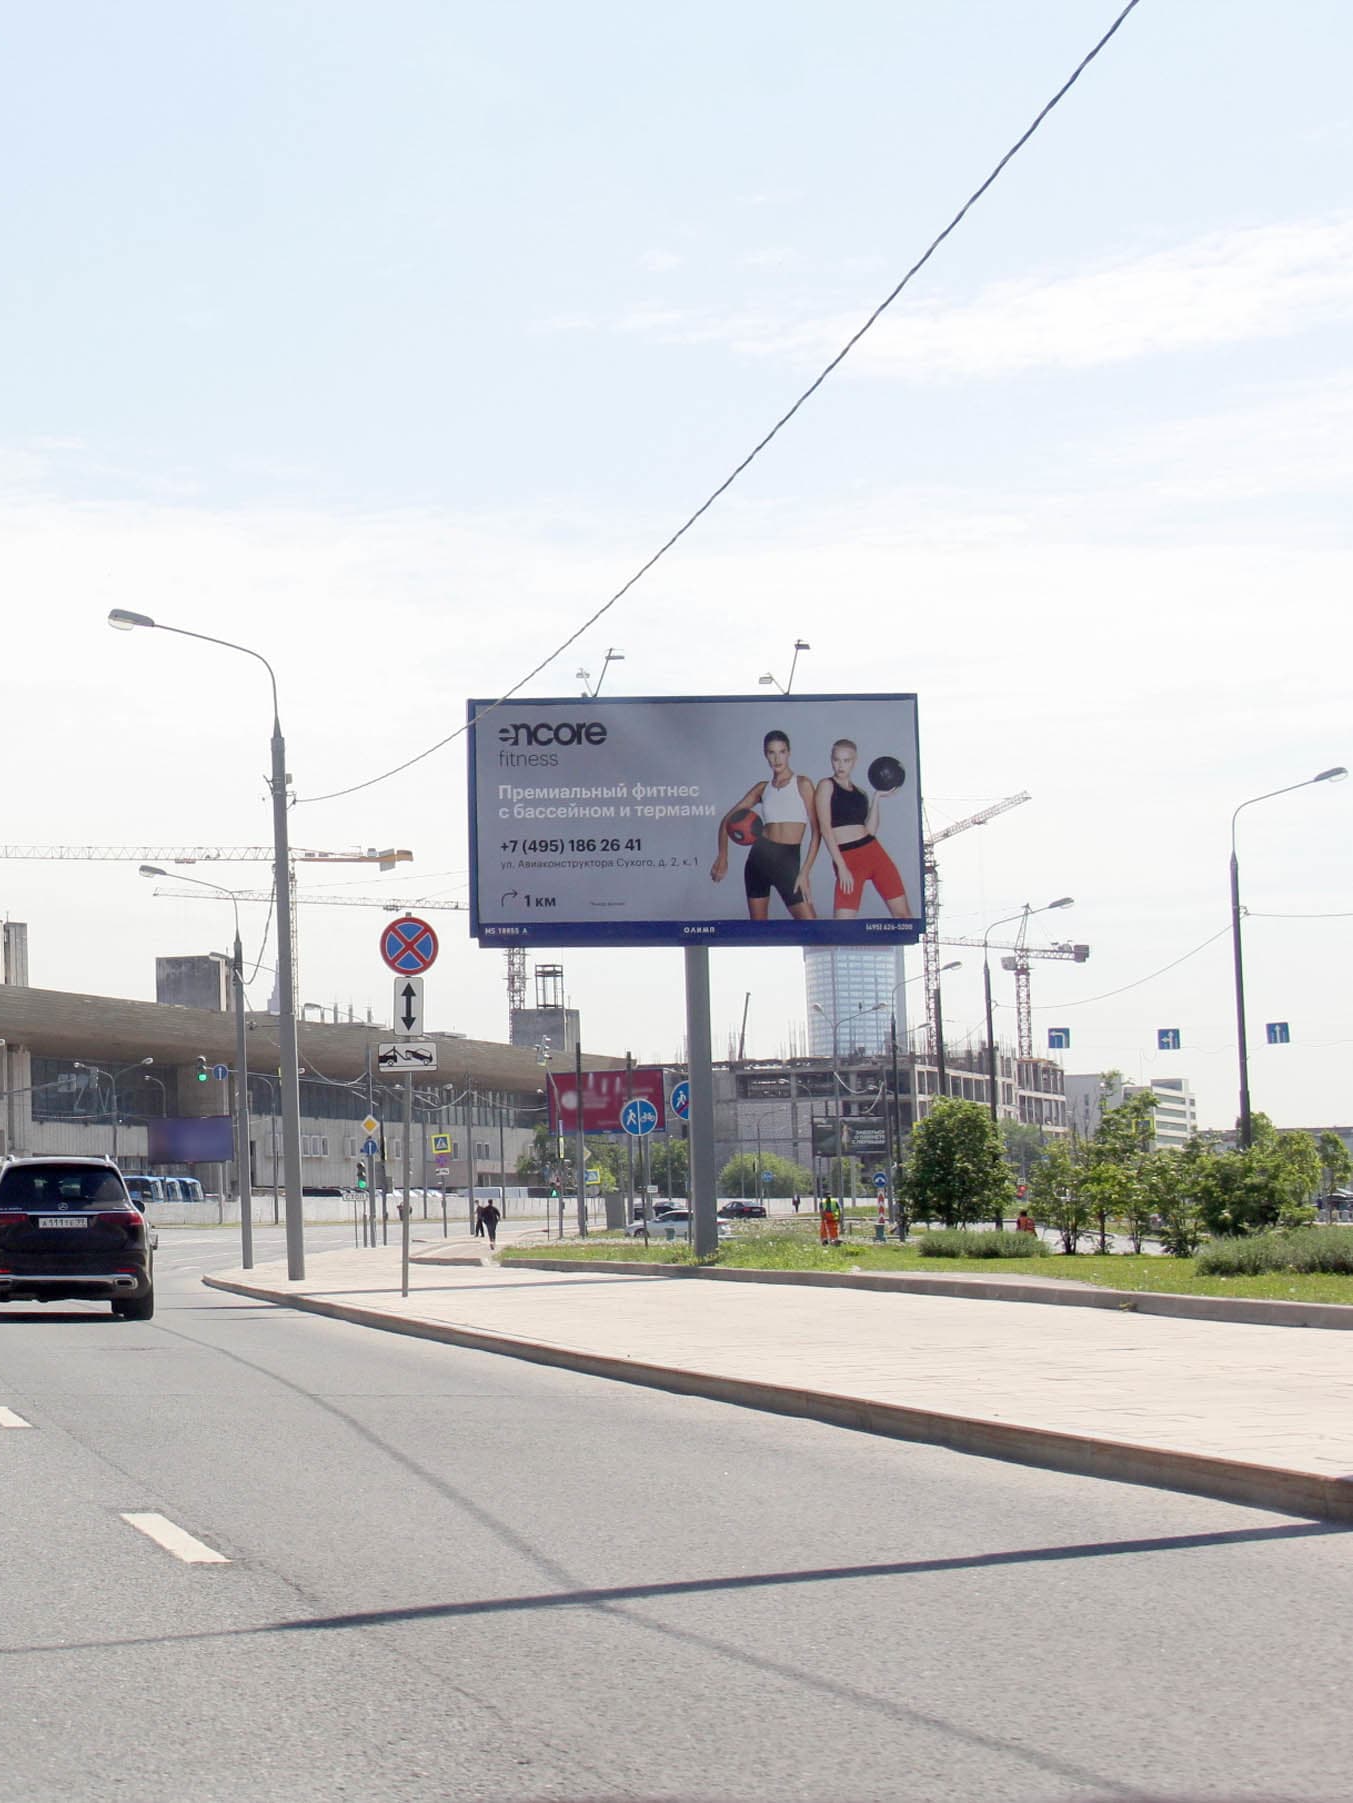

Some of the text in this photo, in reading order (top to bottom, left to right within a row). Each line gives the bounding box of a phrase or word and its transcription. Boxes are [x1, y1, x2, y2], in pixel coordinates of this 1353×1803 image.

[498, 722, 607, 746] encore
[498, 750, 559, 768] fitness
[498, 782, 699, 801] Премиальный фитнес
[499, 803, 716, 819] с бассейном и термами
[500, 837, 642, 855] +7 (495) 186 26 41
[500, 861, 515, 870] ул.
[518, 858, 614, 869] Авиаконструктора
[616, 857, 656, 868] Сухого,
[524, 894, 557, 908] 1 км
